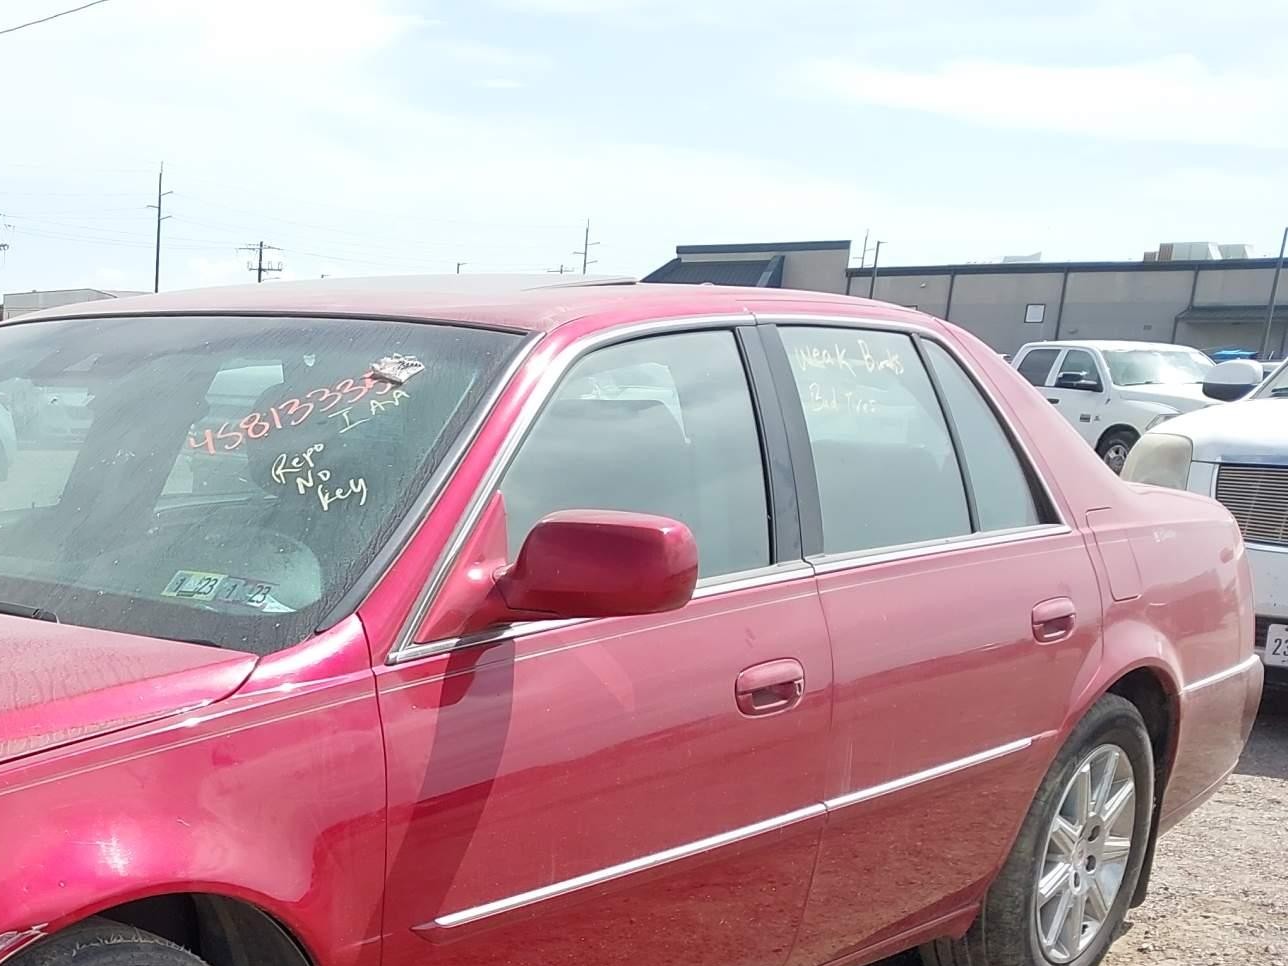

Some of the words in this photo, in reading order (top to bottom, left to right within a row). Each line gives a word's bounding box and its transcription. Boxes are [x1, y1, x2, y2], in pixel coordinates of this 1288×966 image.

[271, 443, 325, 484] Repo
[198, 577, 218, 595] 23
[248, 584, 272, 603] 23
